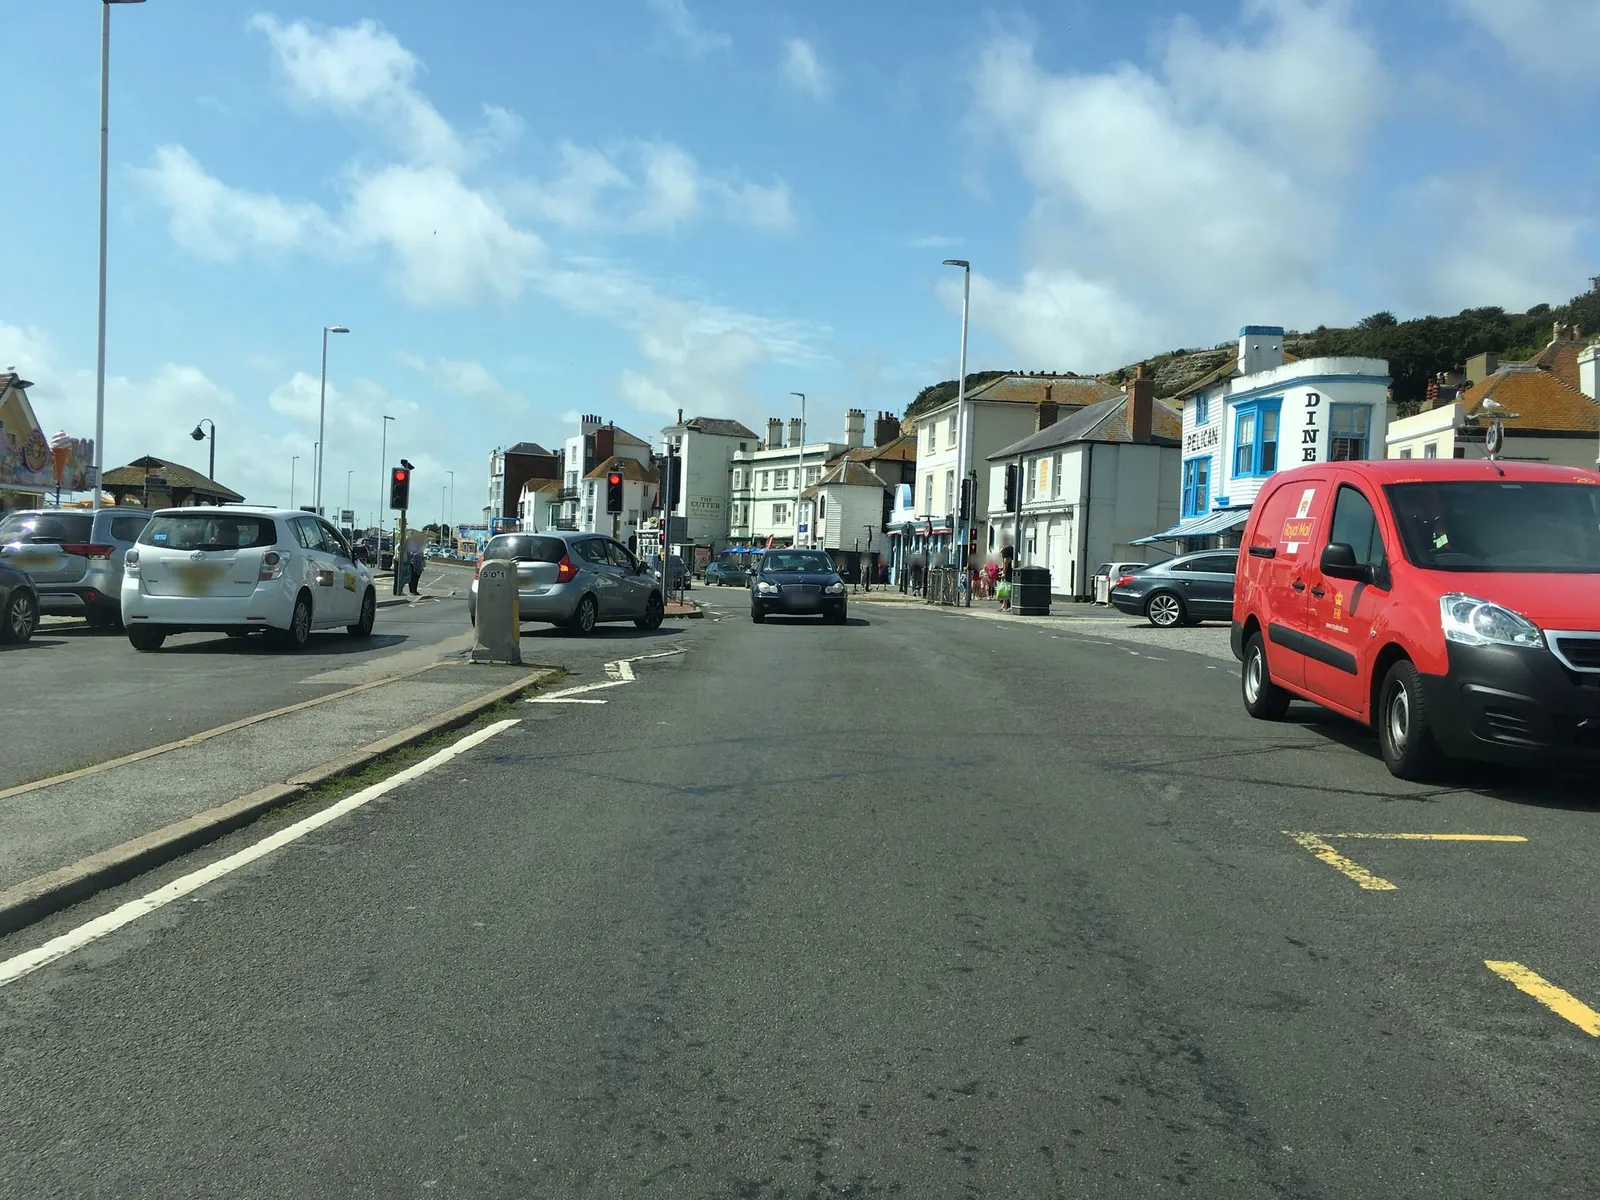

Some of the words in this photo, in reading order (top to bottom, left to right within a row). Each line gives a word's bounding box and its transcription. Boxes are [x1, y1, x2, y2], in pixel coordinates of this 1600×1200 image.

[1187, 426, 1218, 452] PELICAN
[1487, 430, 1496, 444] 20
[690, 501, 721, 509] CUTTER
[1284, 523, 1300, 539] Royal
[1298, 523, 1312, 537] Mail
